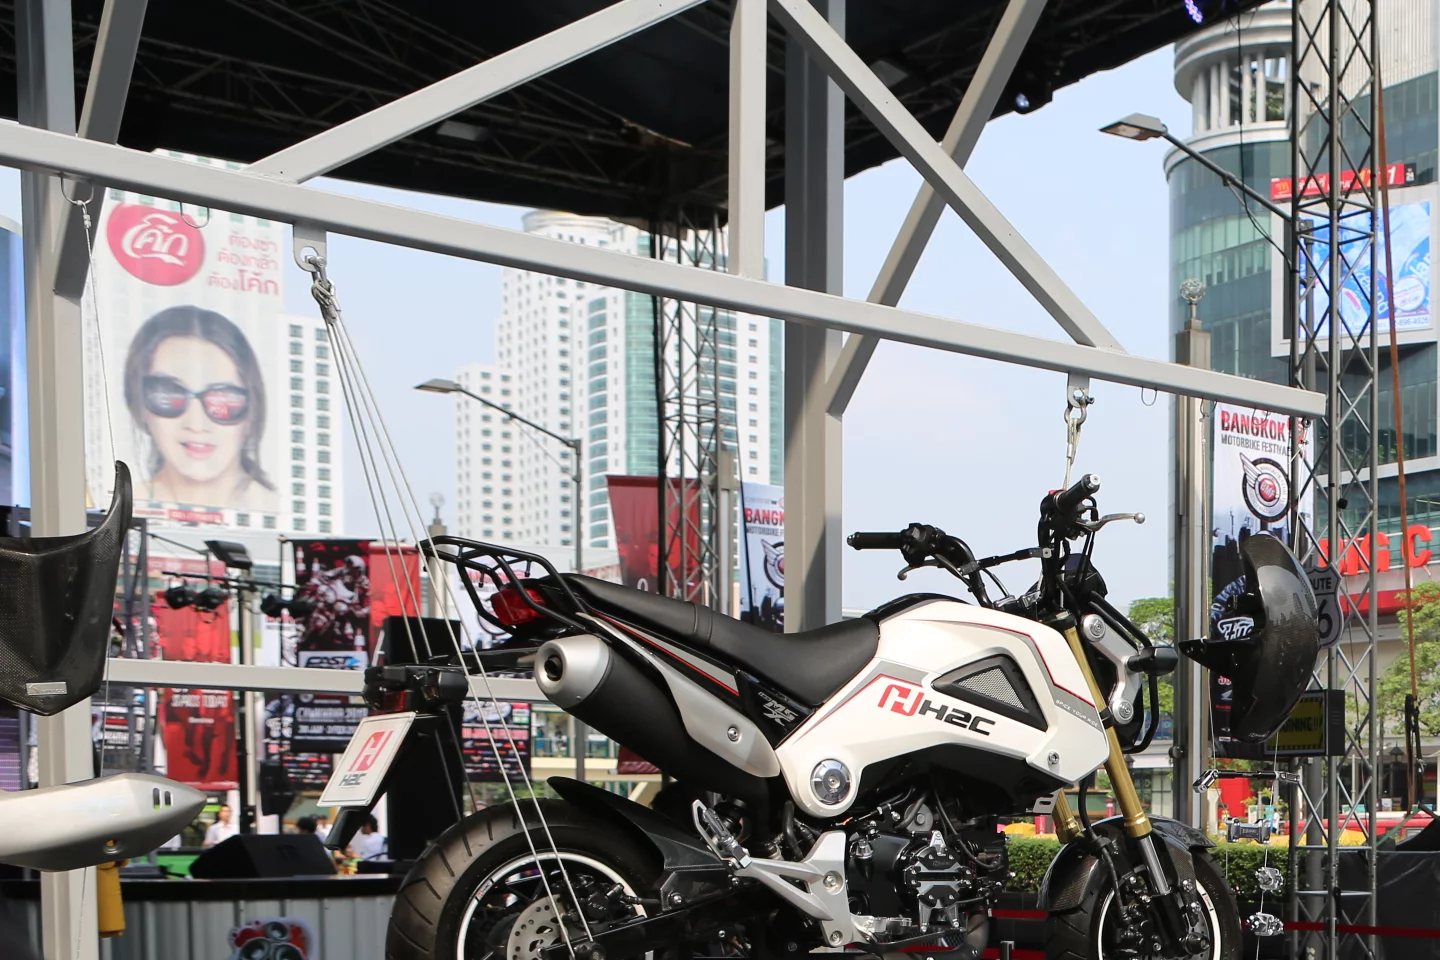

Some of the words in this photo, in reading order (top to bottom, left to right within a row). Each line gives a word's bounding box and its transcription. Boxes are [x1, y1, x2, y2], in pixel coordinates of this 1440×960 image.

[1220, 434, 1261, 451] MOTORBIKE
[1221, 410, 1287, 443] BANGKOK
[1402, 524, 1433, 568] C
[918, 699, 997, 737] H2C
[1055, 699, 1072, 711] SPICE
[1072, 708, 1087, 720] YOUR
